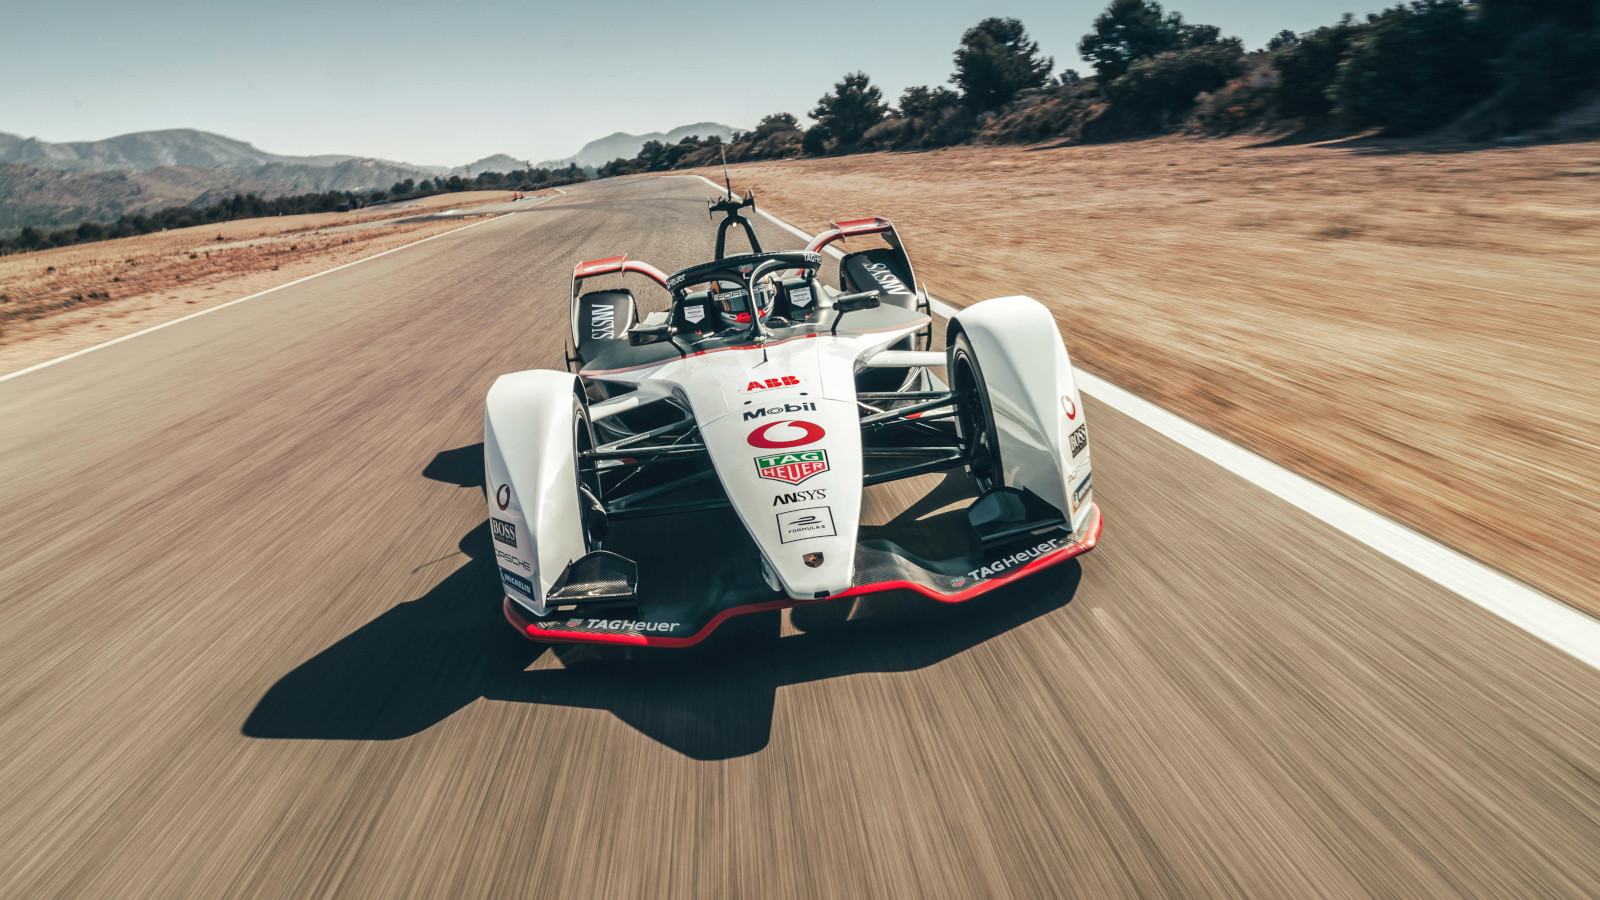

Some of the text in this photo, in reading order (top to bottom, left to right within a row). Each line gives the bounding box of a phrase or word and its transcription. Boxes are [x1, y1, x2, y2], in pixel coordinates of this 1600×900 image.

[865, 262, 910, 295] ANSYS
[591, 304, 615, 340] ANSYS
[746, 375, 801, 392] ABB
[743, 402, 817, 422] Mobil
[761, 451, 820, 467] TAG
[761, 462, 824, 481] HEUER
[772, 488, 827, 507] ANSYS
[493, 519, 516, 541] BOSS
[967, 538, 1059, 581] TAGHeuer
[504, 573, 531, 594] MICHELIN
[586, 618, 681, 632] TAGHeuer
